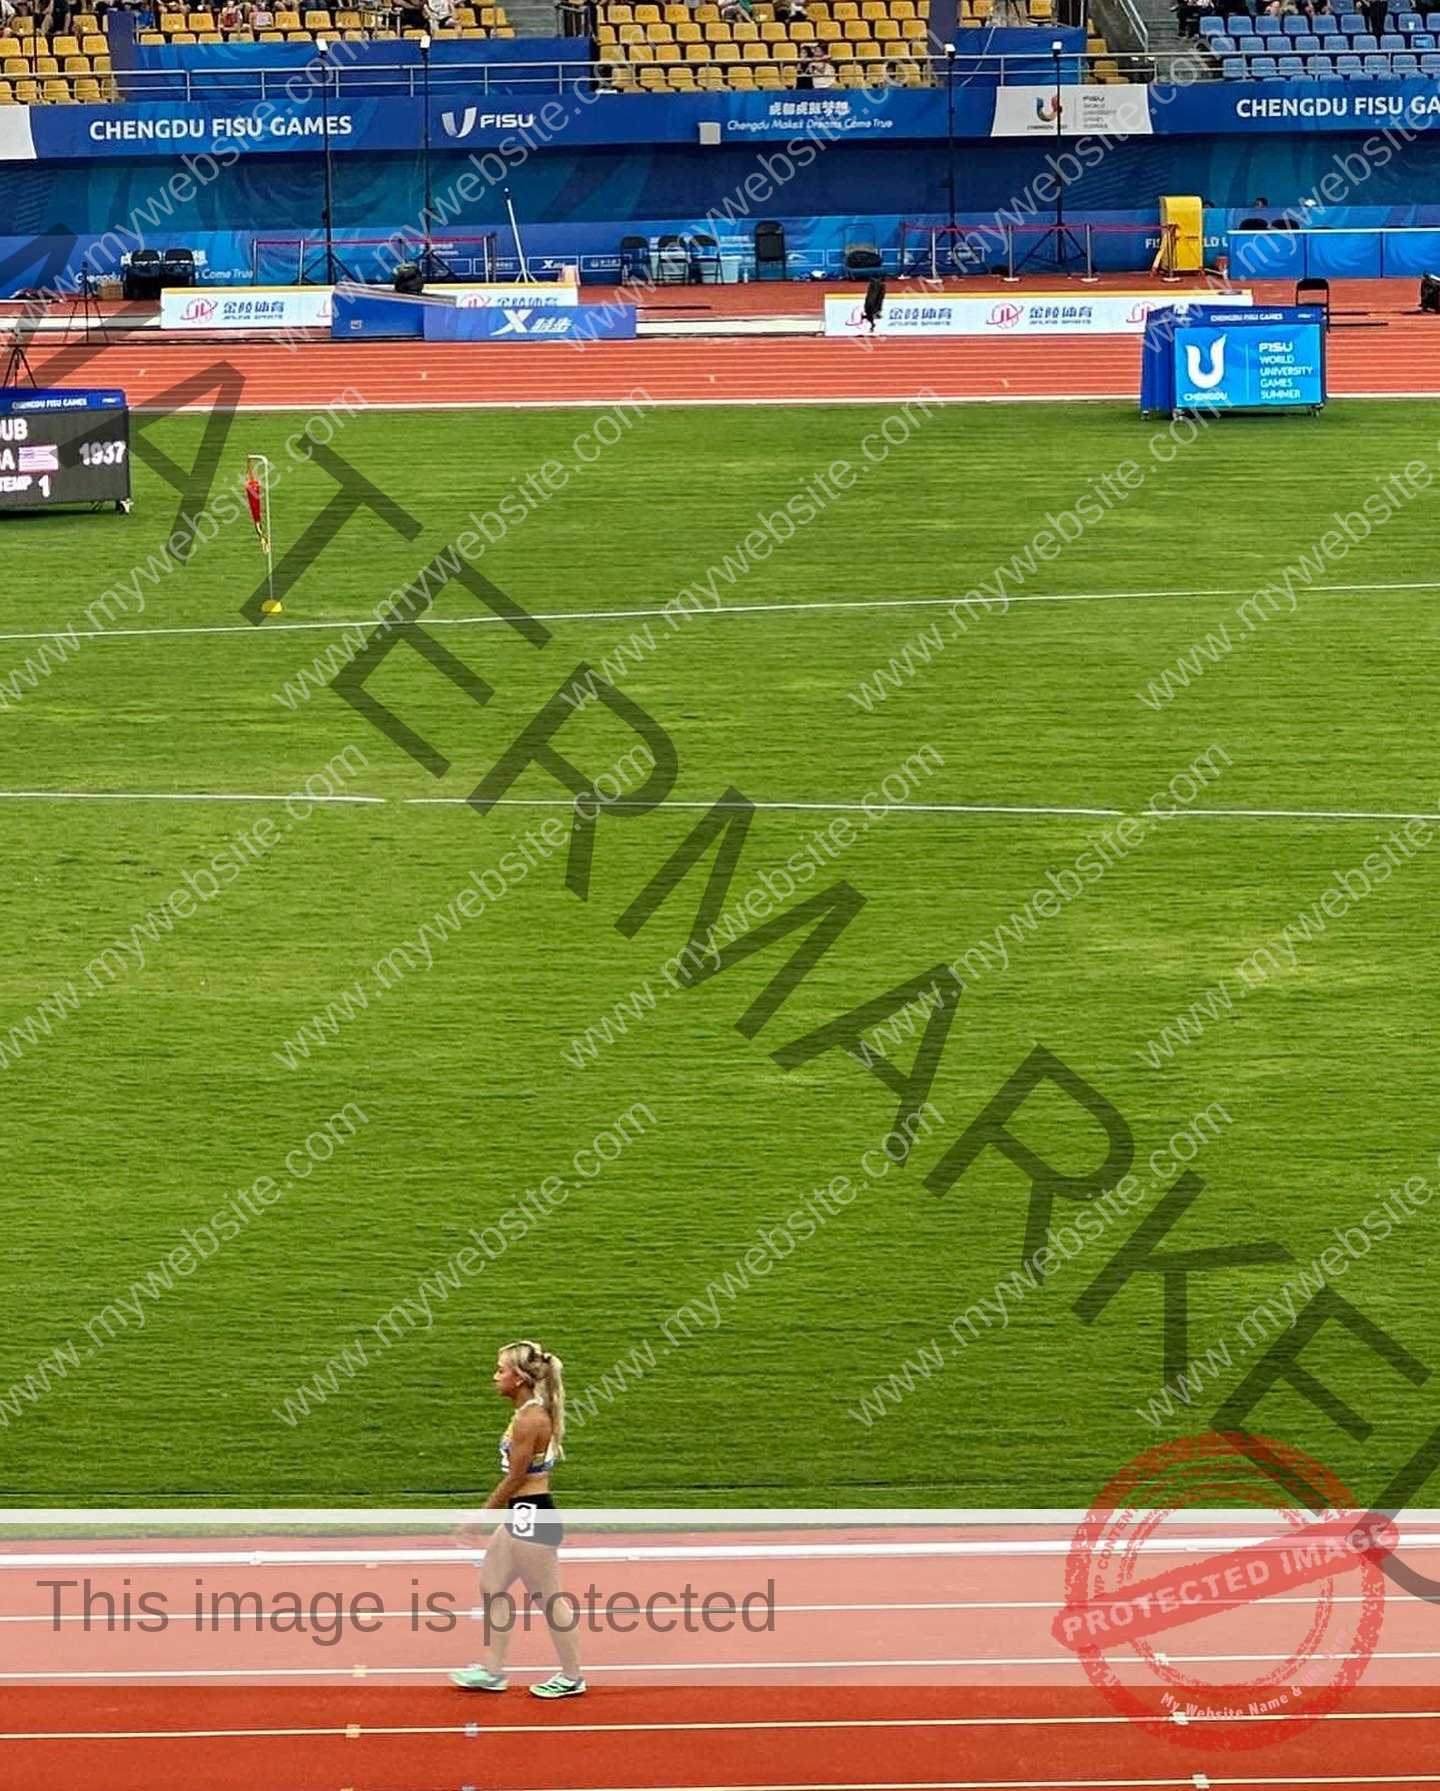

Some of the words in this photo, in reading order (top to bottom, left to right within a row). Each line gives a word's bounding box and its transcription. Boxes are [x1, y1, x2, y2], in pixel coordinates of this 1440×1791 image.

[1236, 97, 1347, 117] CHENGDU
[1354, 96, 1404, 116] FISU
[89, 118, 203, 141] CHENGDU
[211, 117, 263, 138] FISU
[270, 115, 352, 136] GAMES
[480, 113, 535, 129] FISU
[727, 120, 769, 132] Chengdu
[843, 118, 872, 129] Come
[873, 118, 894, 129] True
[202, 269, 232, 280] Come
[232, 268, 254, 279] True
[1258, 342, 1294, 353] FISU
[1259, 355, 1295, 364] WORLD
[1260, 366, 1313, 377] UNIVERSITY
[1261, 379, 1293, 388] GAMES
[1183, 391, 1228, 401] CHENGDU
[1261, 389, 1300, 399] SUMMER
[0, 418, 28, 441] UB
[0, 448, 16, 471] A
[79, 440, 127, 465] 1937
[38, 474, 51, 498] 1
[514, 1504, 532, 1534] 3
